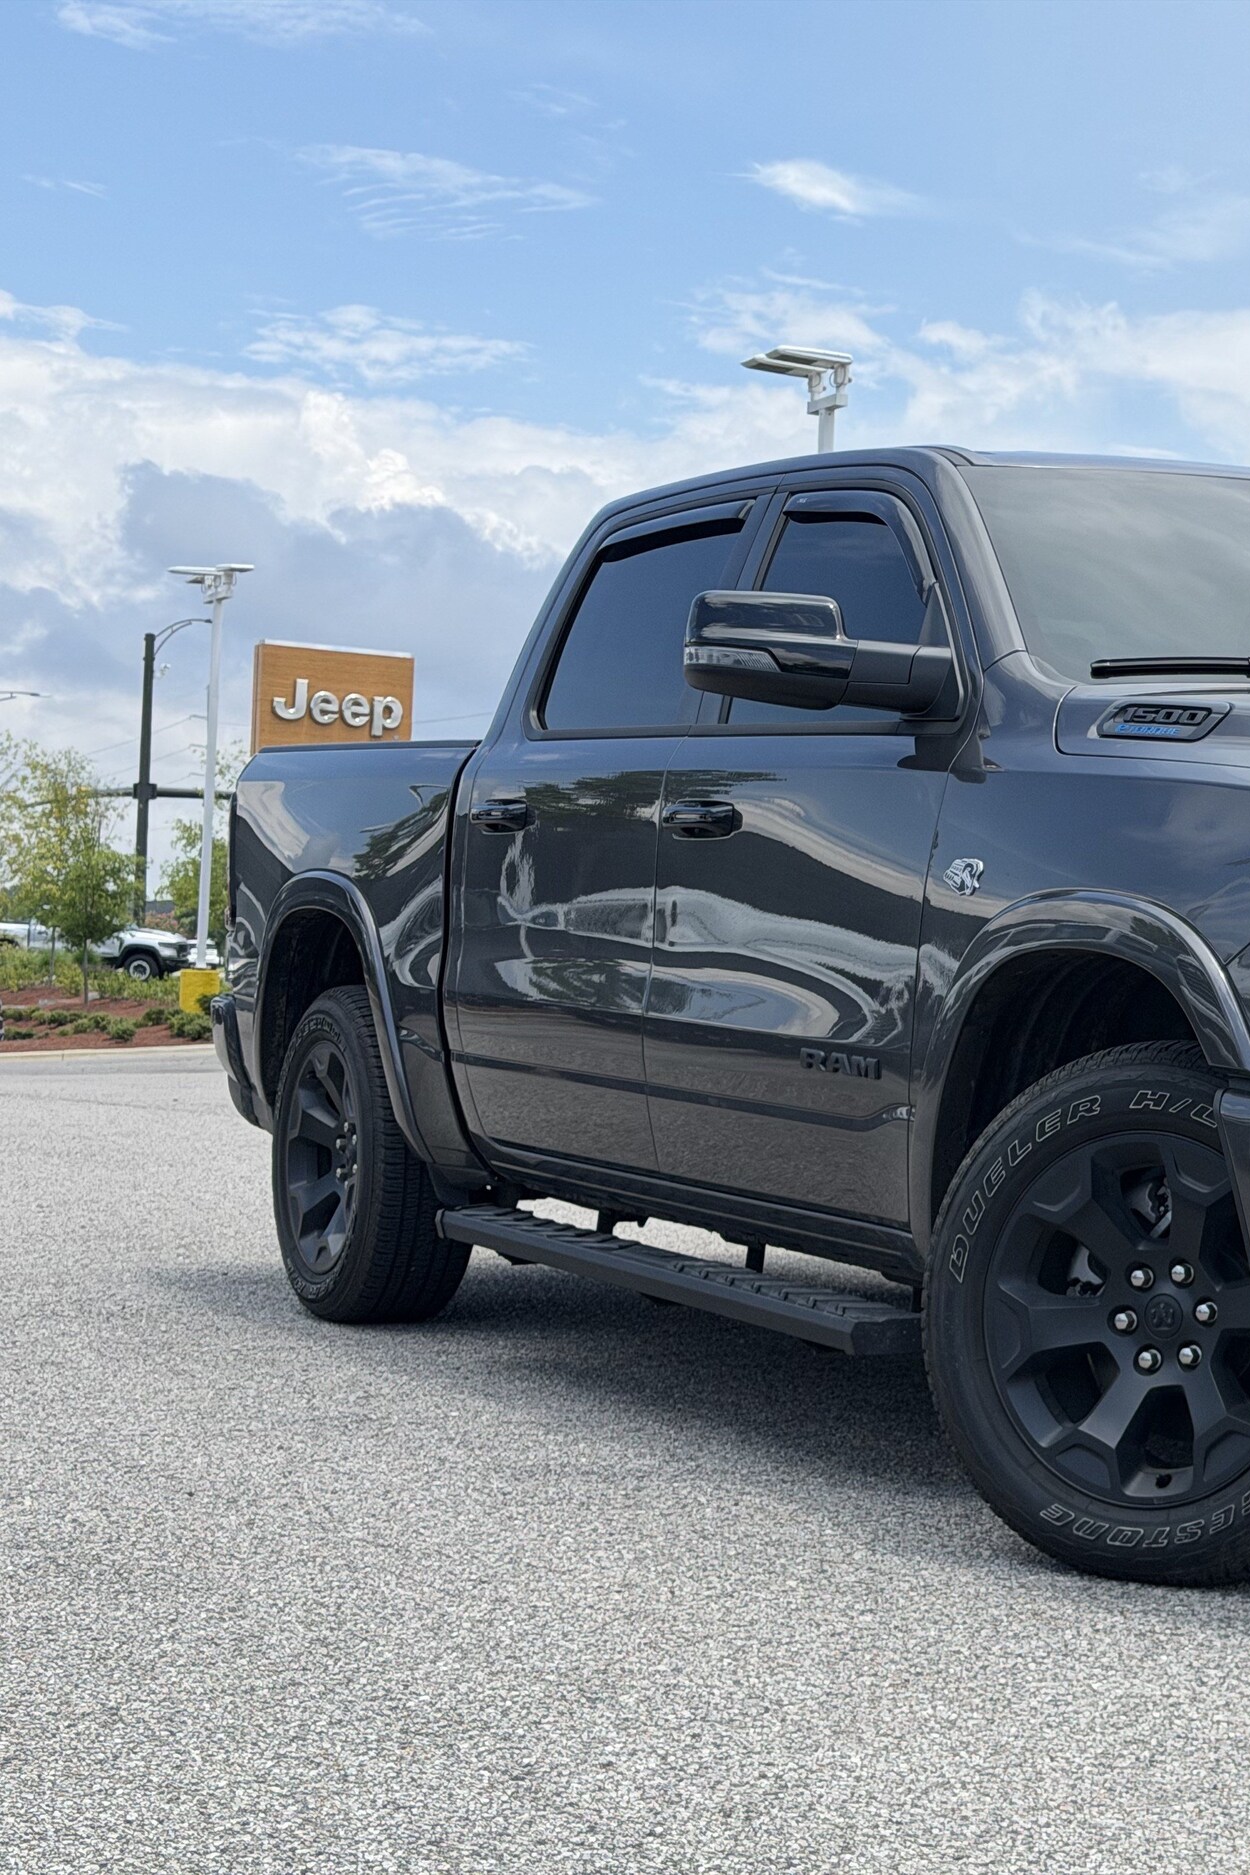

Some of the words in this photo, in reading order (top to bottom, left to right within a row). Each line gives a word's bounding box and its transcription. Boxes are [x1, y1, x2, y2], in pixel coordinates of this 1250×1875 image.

[272, 678, 403, 737] Jeep
[1121, 707, 1208, 725] 1500
[801, 1048, 881, 1080] RAM
[949, 1095, 1101, 1283] DUELER
[1129, 1090, 1218, 1128] H/L
